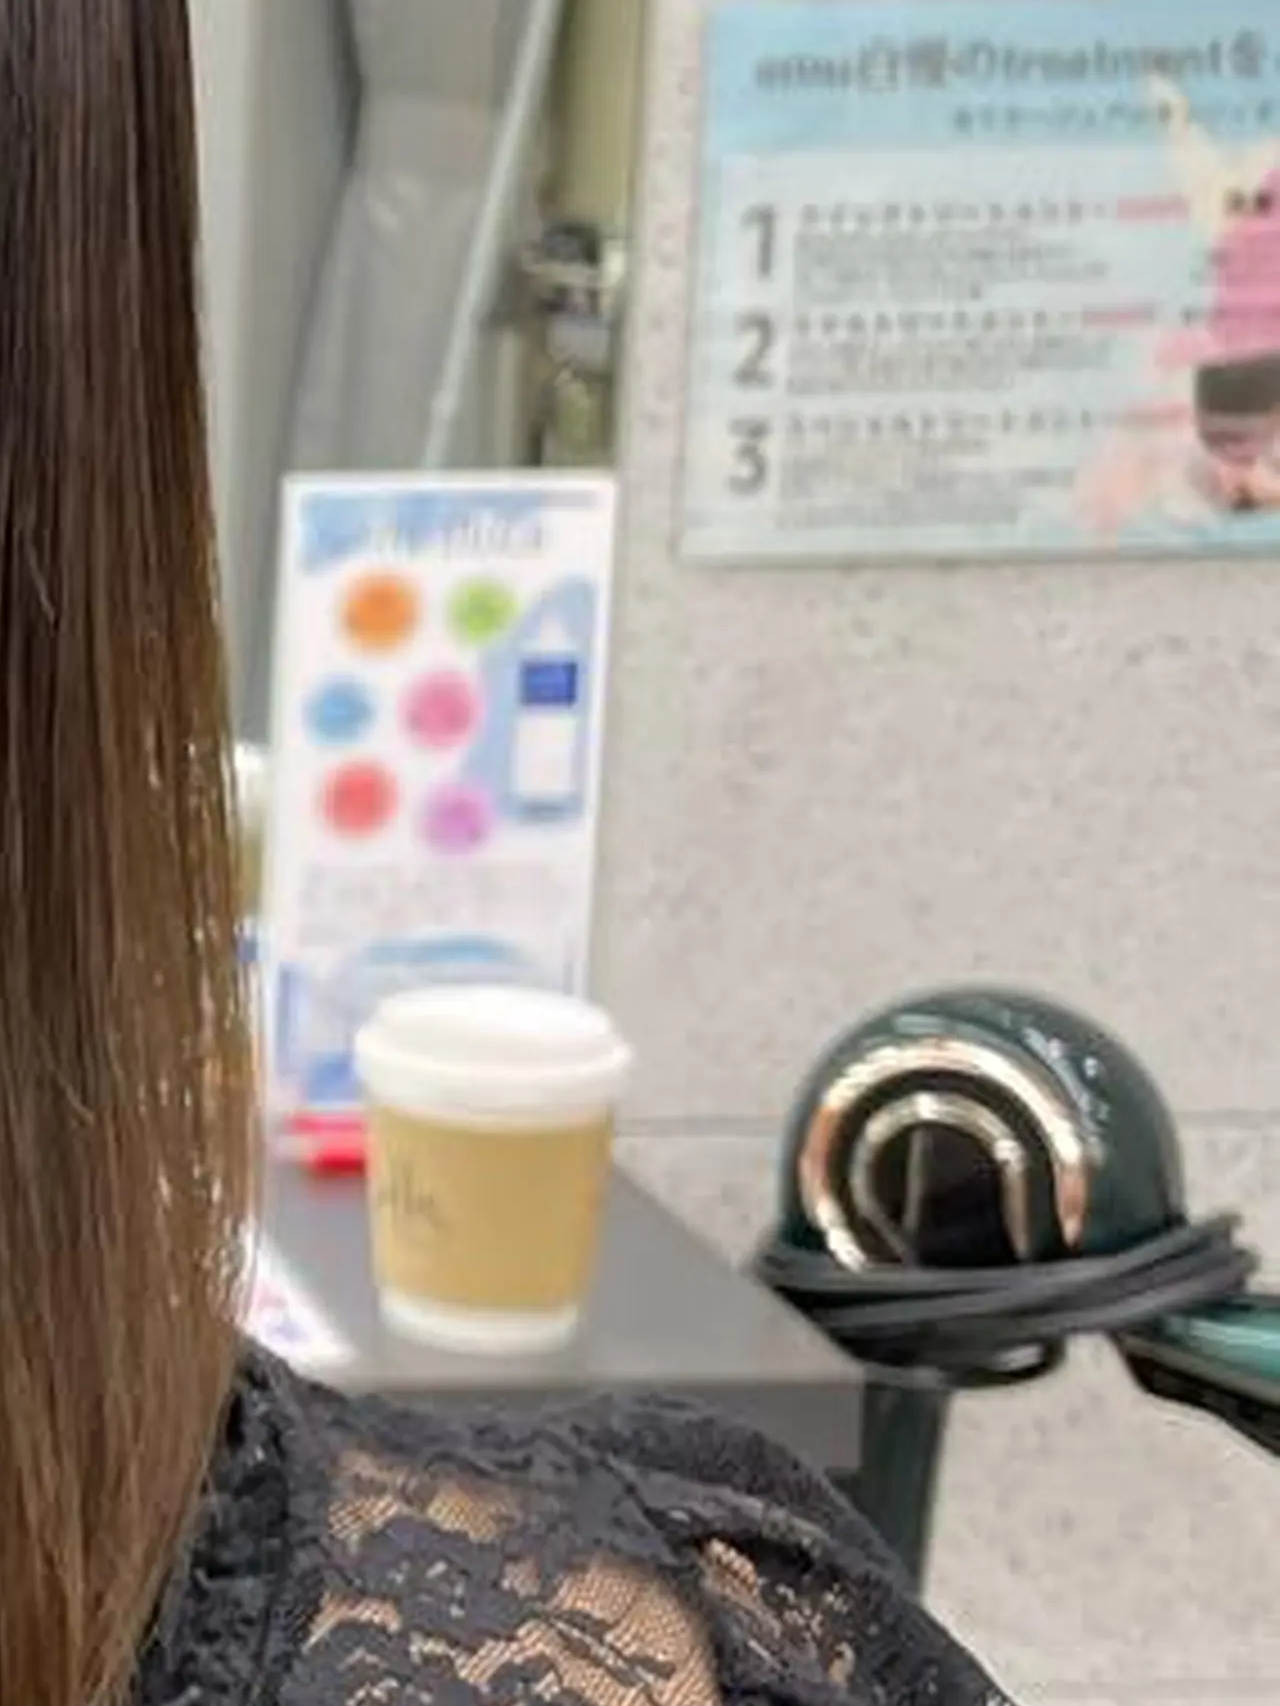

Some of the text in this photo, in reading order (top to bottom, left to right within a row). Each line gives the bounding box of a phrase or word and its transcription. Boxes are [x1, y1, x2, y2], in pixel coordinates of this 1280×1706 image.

[743, 205, 775, 279] 1
[734, 314, 774, 389] 2
[729, 419, 768, 493] 3
